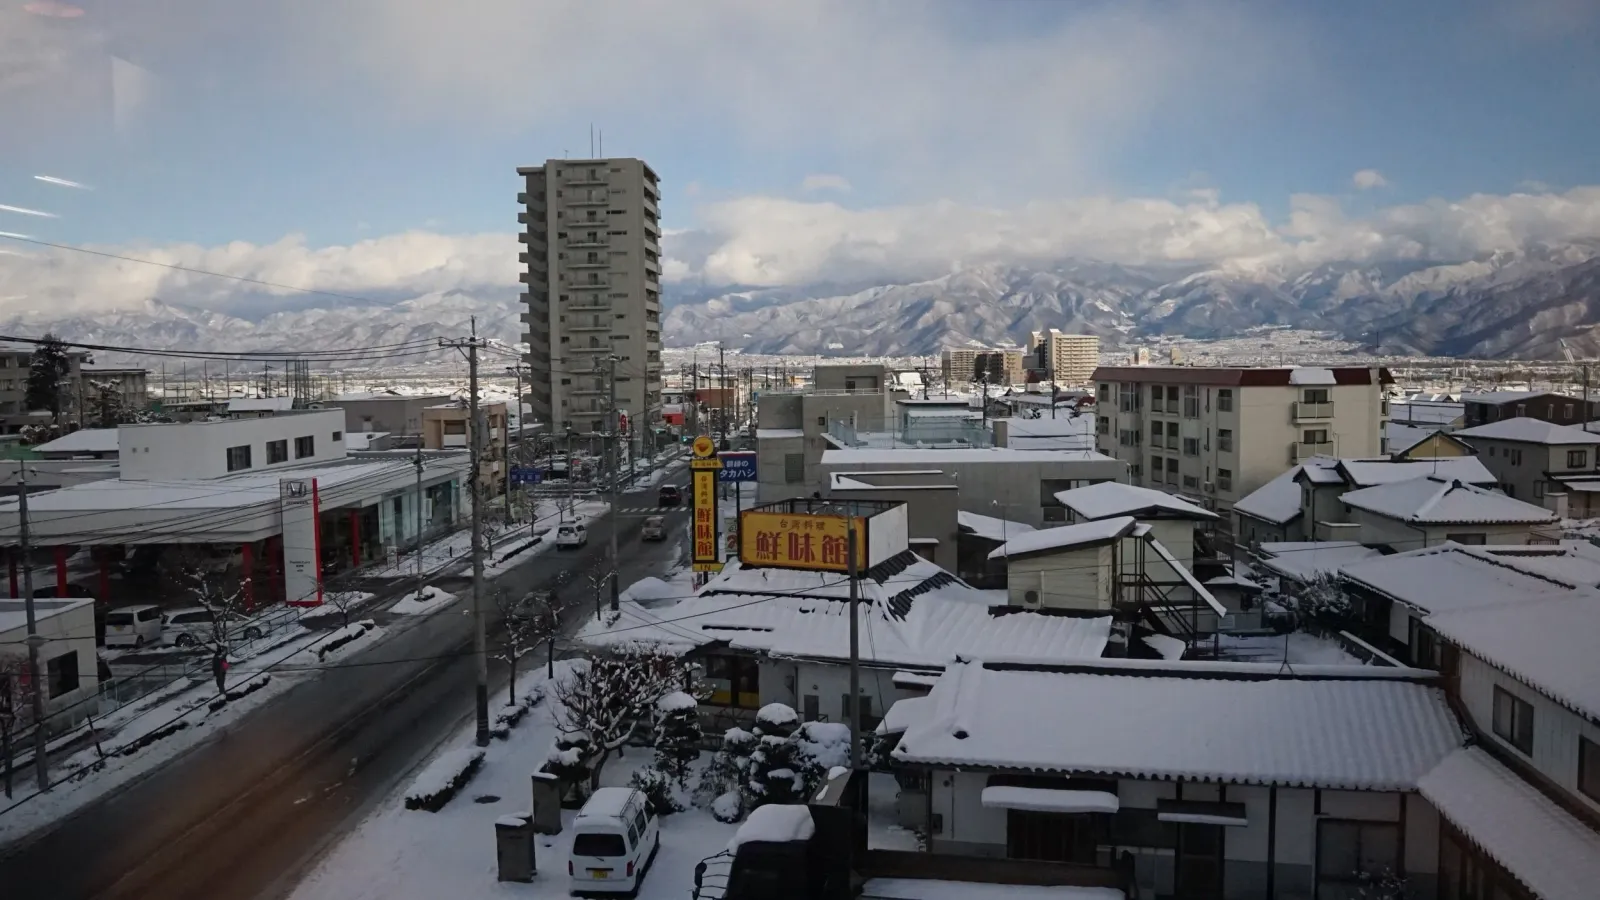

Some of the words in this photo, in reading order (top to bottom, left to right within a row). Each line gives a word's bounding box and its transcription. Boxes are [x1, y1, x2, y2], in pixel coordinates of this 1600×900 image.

[719, 468, 756, 478] タカハシ
[696, 507, 712, 557] 鮮味館
[756, 530, 849, 564] 鮮味館
[700, 564, 711, 572] IN
